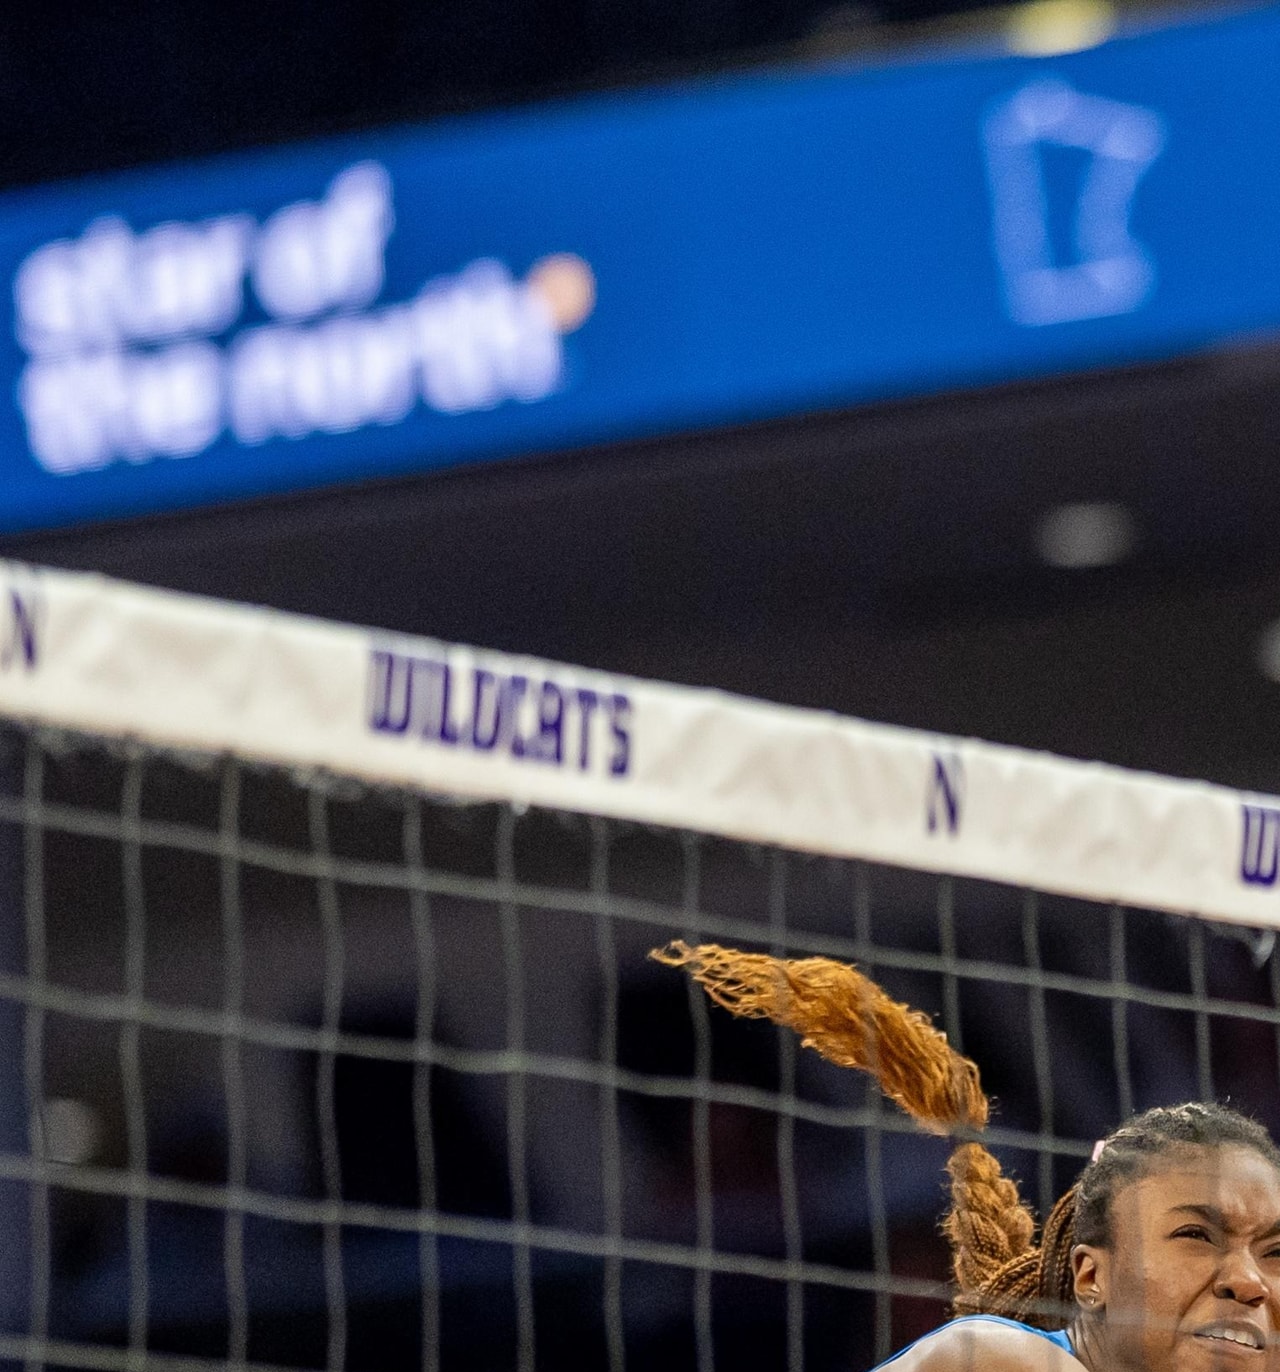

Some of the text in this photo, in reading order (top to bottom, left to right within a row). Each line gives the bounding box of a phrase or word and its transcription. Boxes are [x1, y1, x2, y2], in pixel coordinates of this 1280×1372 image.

[252, 160, 394, 320] of
[20, 336, 222, 474] the
[368, 648, 632, 774] WILDCATS
[926, 752, 966, 836] N
